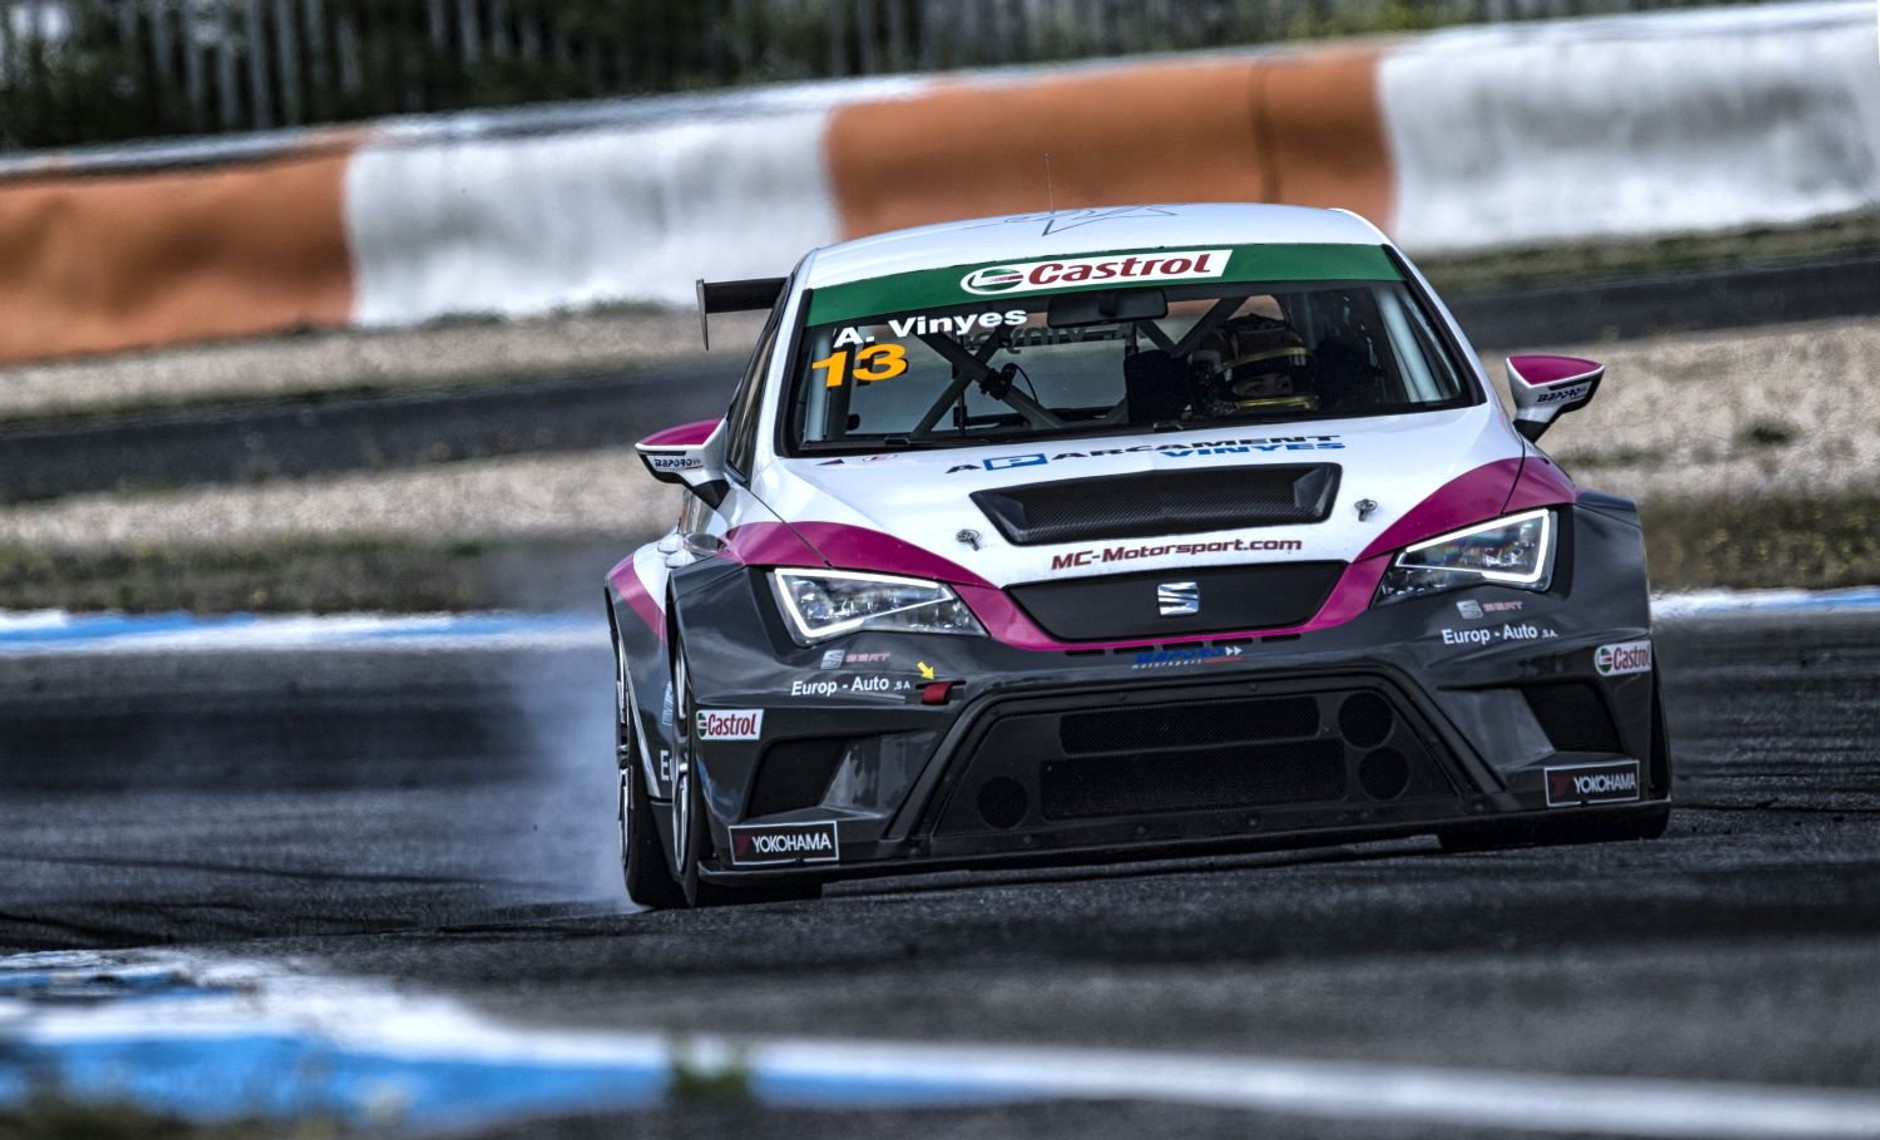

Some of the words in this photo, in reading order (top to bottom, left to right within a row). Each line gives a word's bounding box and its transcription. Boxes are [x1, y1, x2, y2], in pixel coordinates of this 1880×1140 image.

[1028, 253, 1211, 285] Castrol
[833, 326, 875, 348] A.
[888, 310, 1027, 338] Vinyes
[812, 343, 908, 388] 13
[1160, 442, 1346, 457] VINYES
[1051, 538, 1303, 570] MC-Motorsport.com
[1441, 629, 1491, 645] Europ
[1503, 624, 1538, 640] Auto
[791, 680, 837, 697] Europ
[851, 676, 890, 692] Auto
[708, 713, 757, 736] Castrol
[1573, 772, 1637, 795] YOKOHAMA
[752, 832, 832, 854] YOKOHAMA
